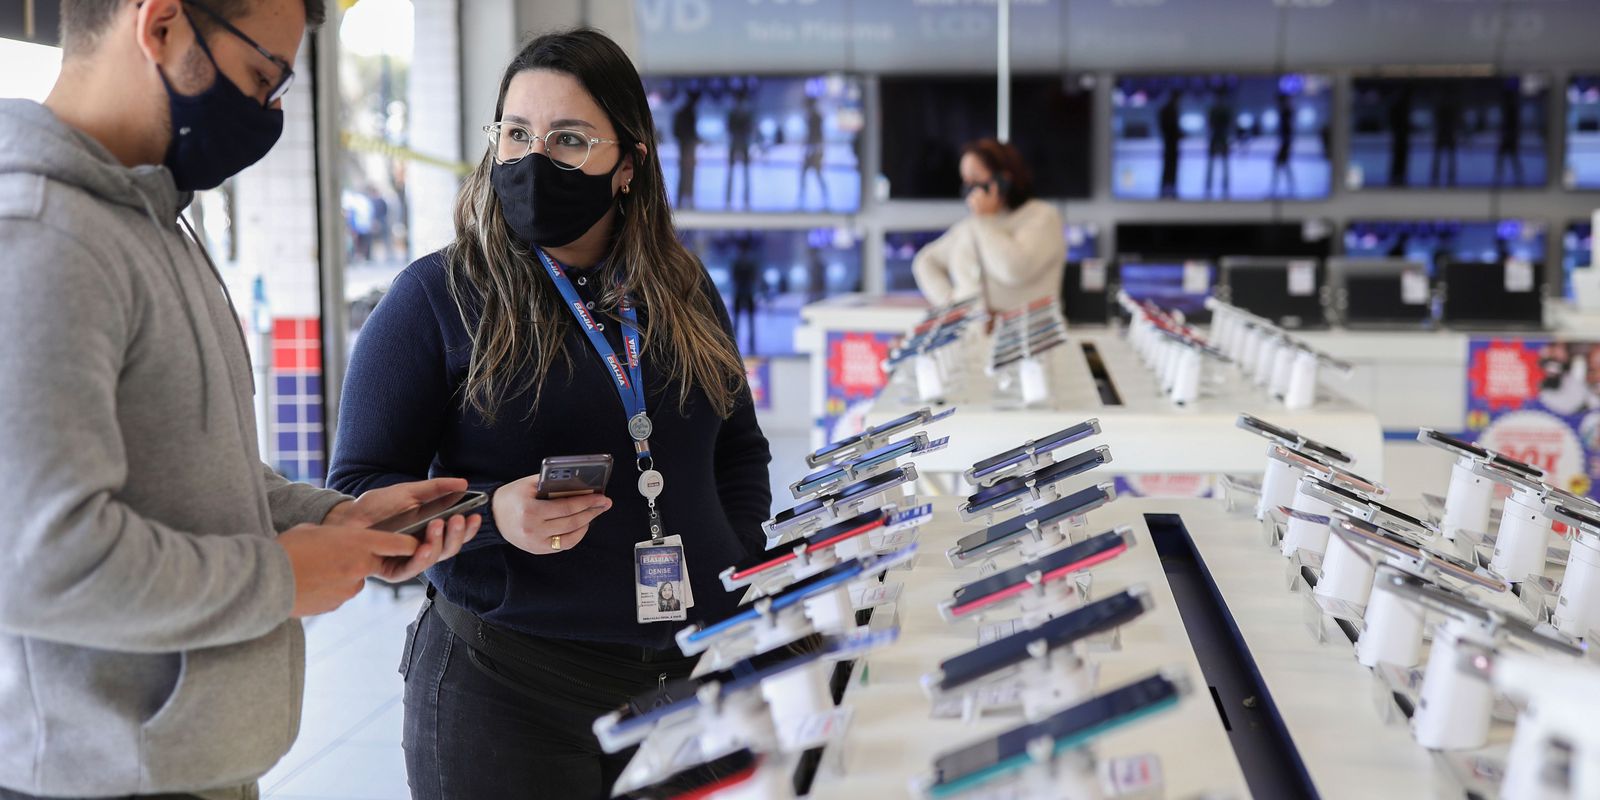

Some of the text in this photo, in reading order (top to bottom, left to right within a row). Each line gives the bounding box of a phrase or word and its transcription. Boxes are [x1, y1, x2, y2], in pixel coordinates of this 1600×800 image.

[573, 302, 594, 331] BAHIA
[606, 355, 625, 387] BAHIA
[643, 556, 670, 564] BAHIA
[648, 567, 672, 575] DENISE
